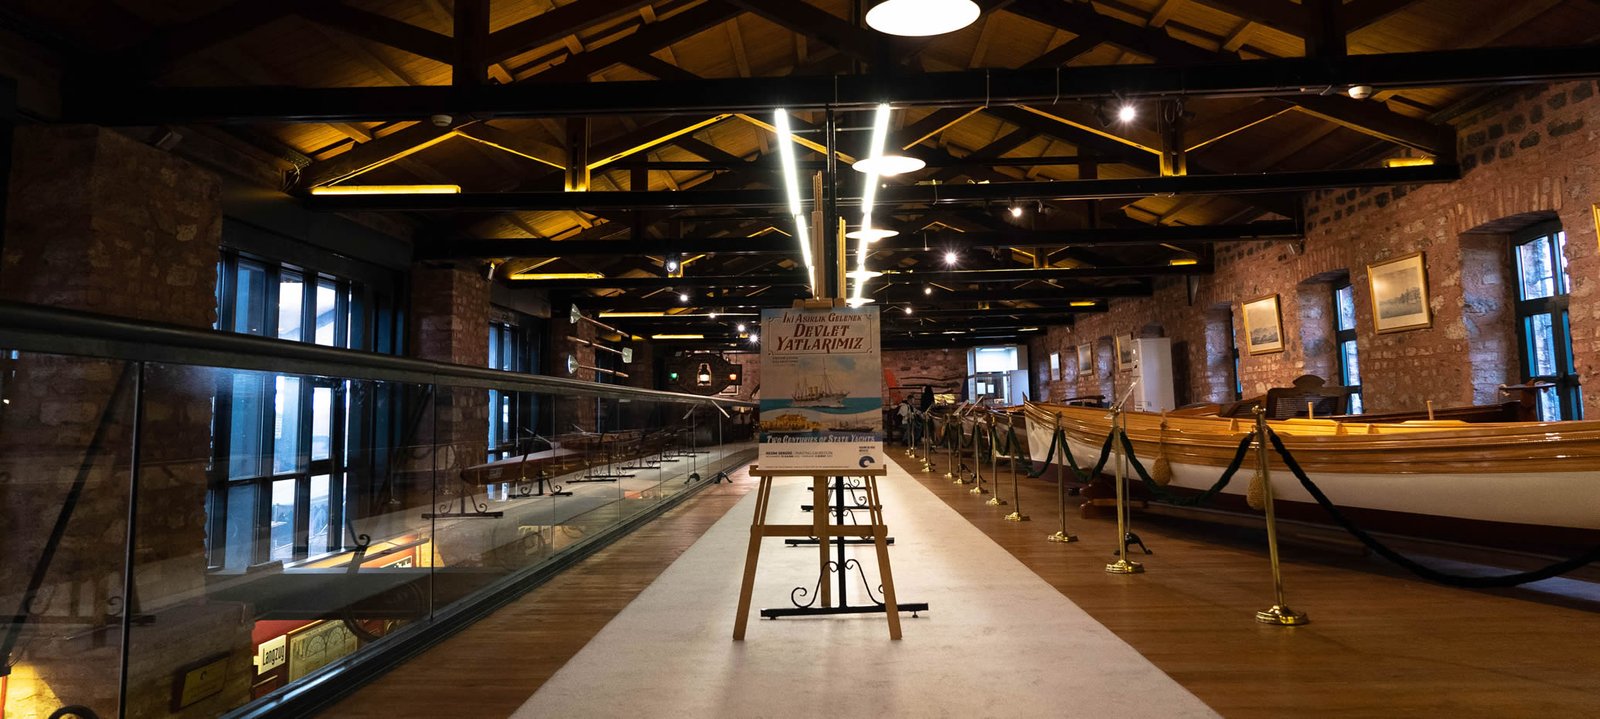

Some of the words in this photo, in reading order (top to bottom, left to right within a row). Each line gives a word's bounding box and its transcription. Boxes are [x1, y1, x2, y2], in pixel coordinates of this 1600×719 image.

[794, 323, 850, 337] DEVLET
[777, 336, 864, 354] YATLARIMIZ
[263, 645, 284, 666] Langzug
